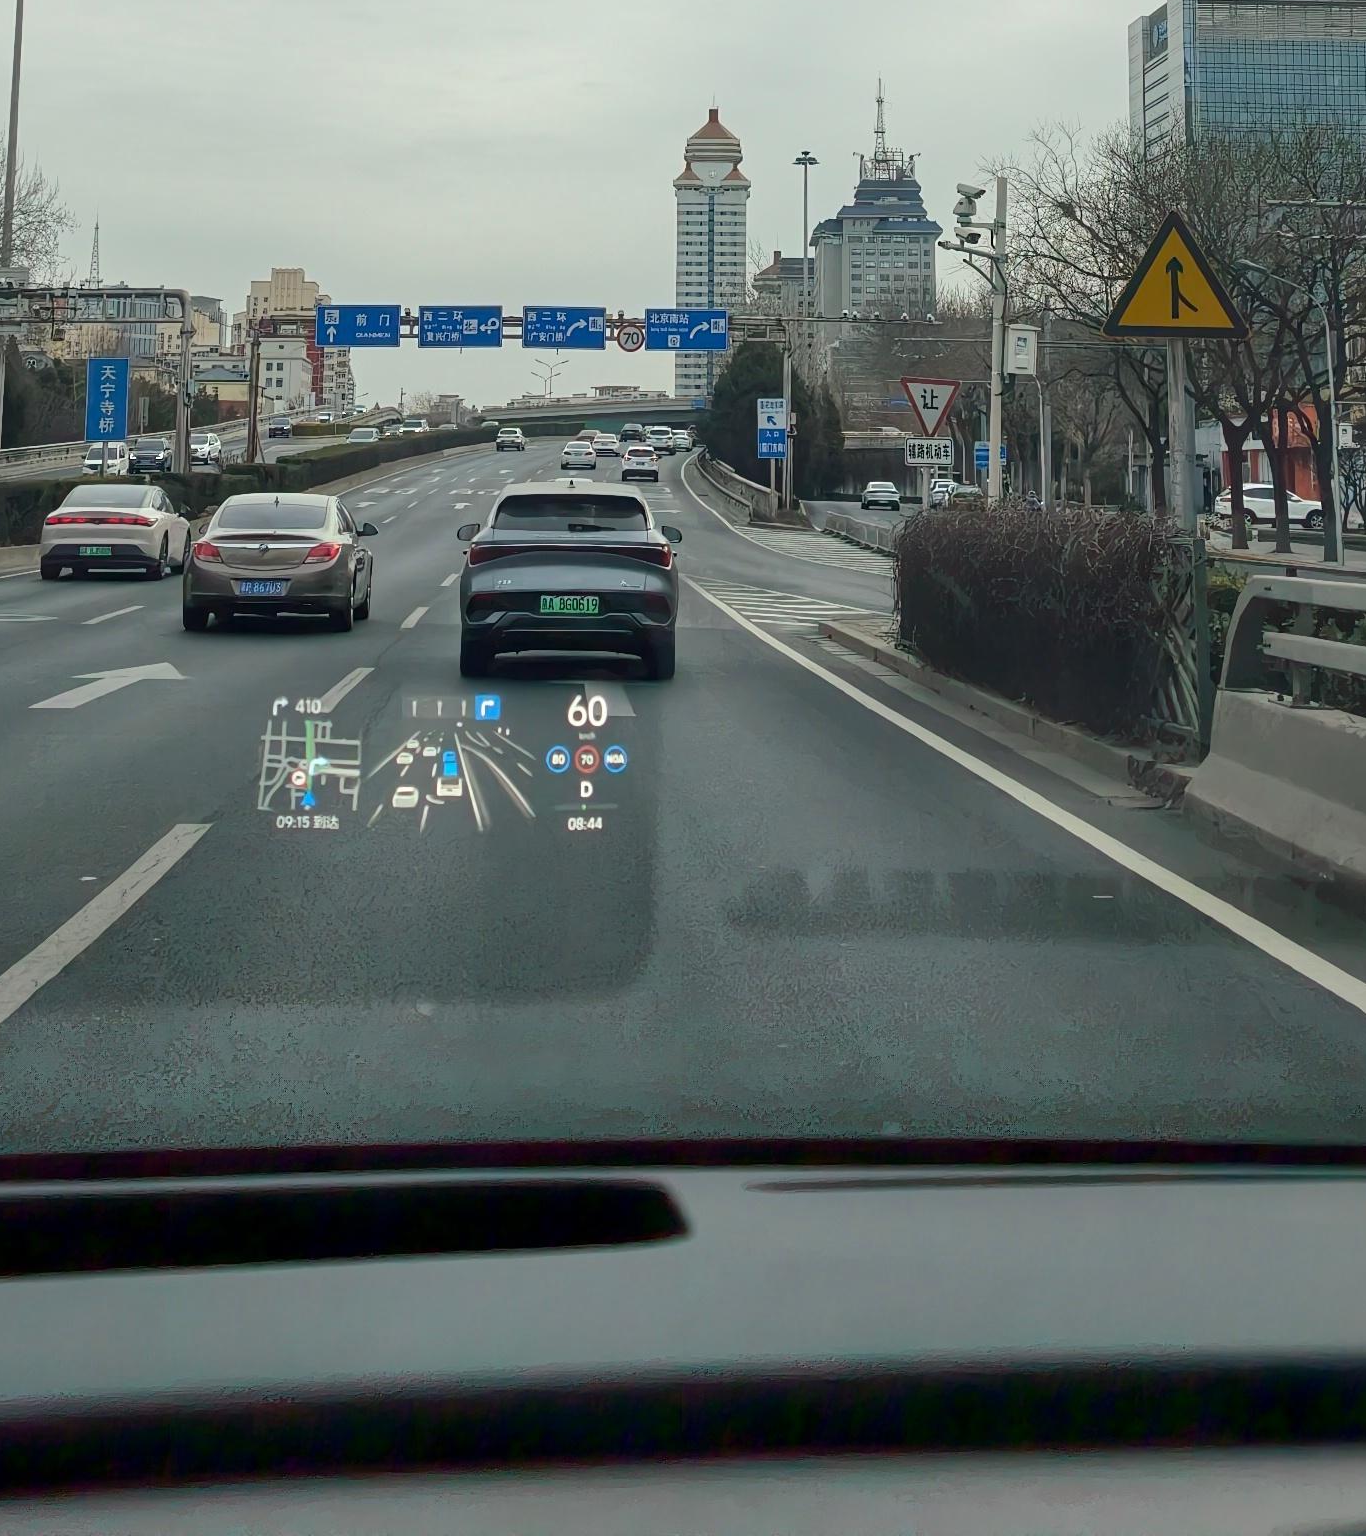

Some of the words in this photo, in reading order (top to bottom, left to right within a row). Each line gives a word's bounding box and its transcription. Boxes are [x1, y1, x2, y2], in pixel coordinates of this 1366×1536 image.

[623, 332, 640, 345] 70
[99, 365, 116, 433] 天宁寺桥
[921, 388, 939, 410] 让
[295, 698, 322, 714] 410
[568, 694, 608, 727] 60
[580, 753, 594, 766] 70
[580, 780, 594, 798] D
[276, 815, 310, 829] 09:15
[567, 816, 603, 830] 08:44
